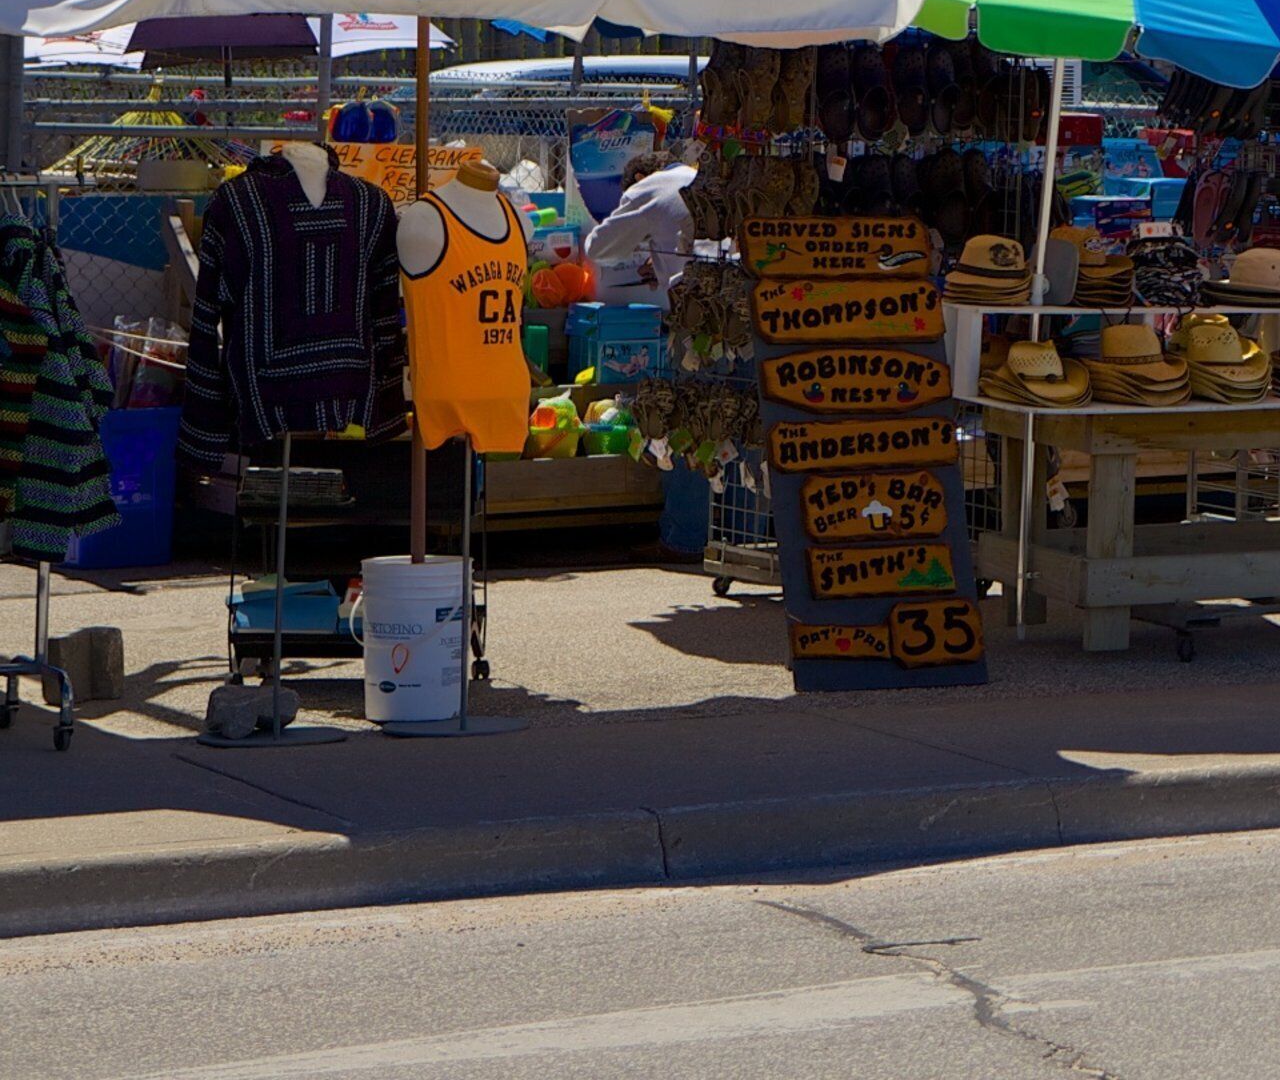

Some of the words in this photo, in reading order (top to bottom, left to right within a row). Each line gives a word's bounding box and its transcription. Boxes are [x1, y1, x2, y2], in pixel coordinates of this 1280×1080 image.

[748, 222, 837, 237] CARVED
[851, 222, 917, 238] SIGNS
[805, 240, 869, 253] ORDER
[812, 256, 866, 269] HERE
[449, 260, 503, 294] WASAGA
[760, 284, 786, 301] THE
[761, 286, 937, 333] THOMPSON'S
[483, 328, 513, 345] 1974
[776, 355, 941, 387] ROBINSON'S
[831, 387, 891, 404] NEST
[778, 427, 808, 439] THE
[779, 422, 953, 464] ANDERSON'S
[888, 478, 942, 509] BAR
[814, 507, 857, 533] BEER
[816, 551, 843, 564] THE
[820, 547, 926, 591] SMITH'S
[898, 603, 975, 656] 35
